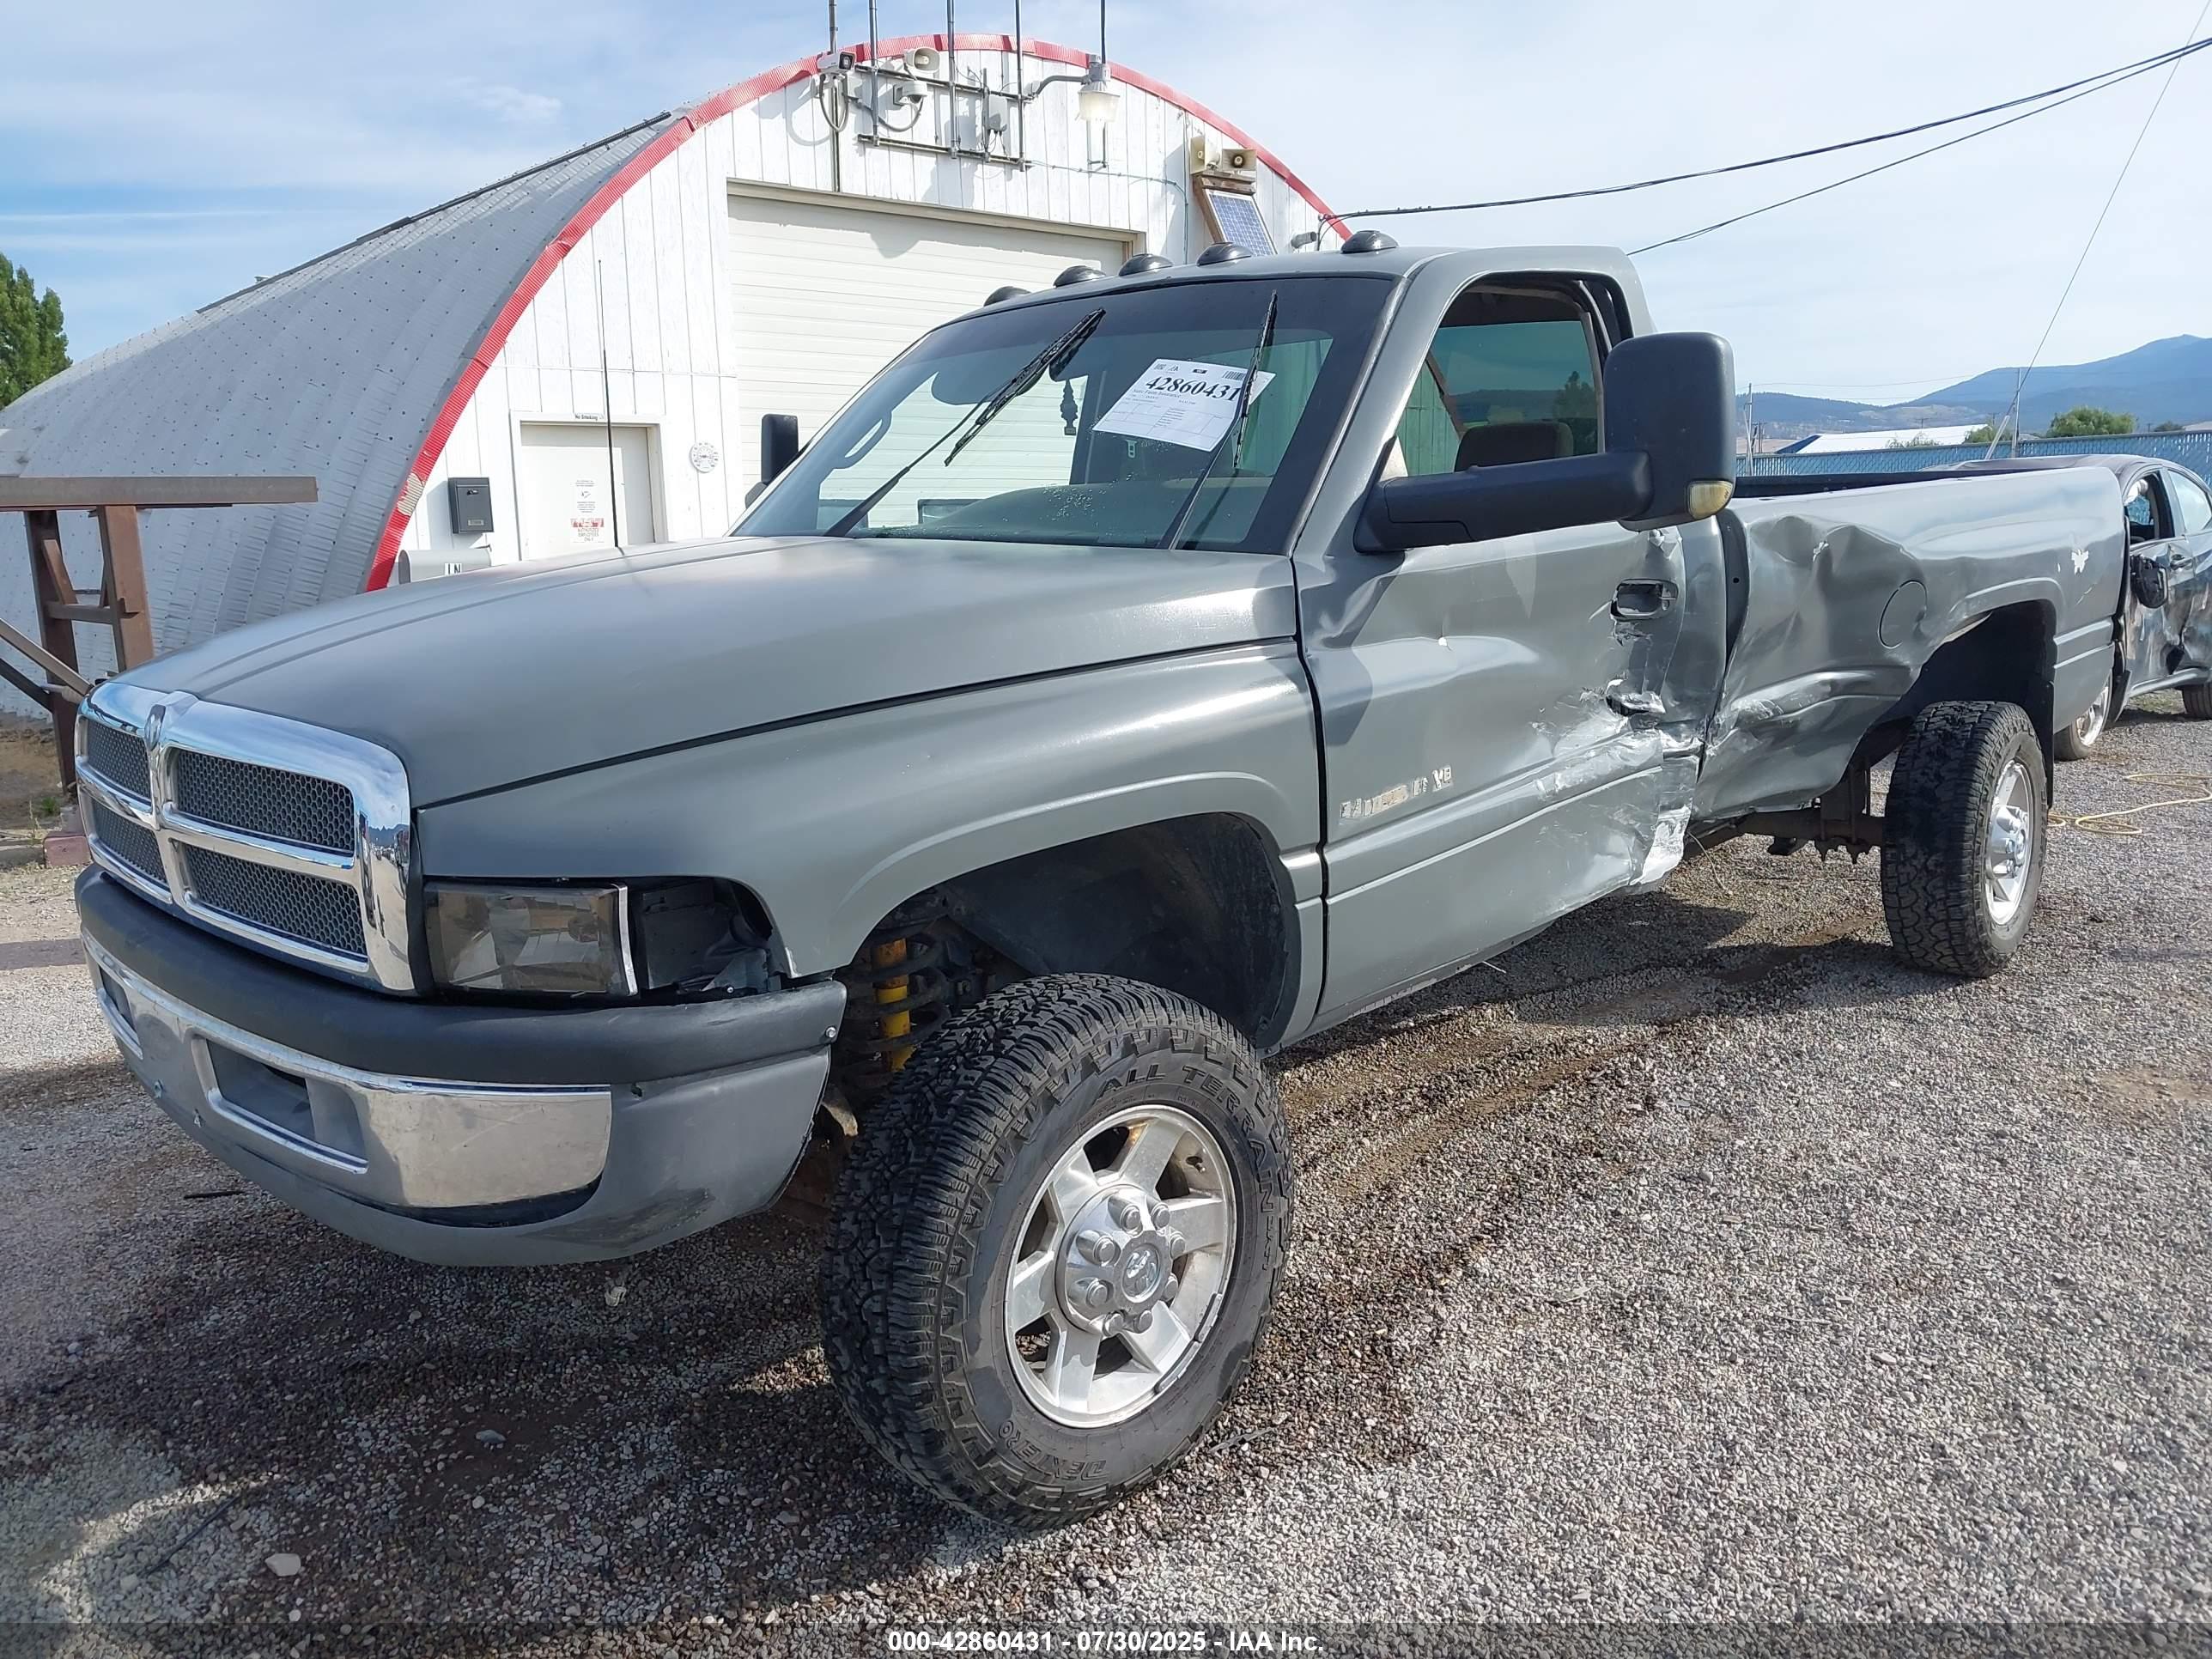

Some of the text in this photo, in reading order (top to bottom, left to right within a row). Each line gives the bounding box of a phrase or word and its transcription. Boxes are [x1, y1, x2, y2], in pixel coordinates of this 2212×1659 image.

[1146, 376, 1243, 401] 42860431
[1100, 1063, 1166, 1098] ALL
[1182, 1064, 1275, 1212] TERRAIN
[998, 1419, 1110, 1481] DEXTERO
